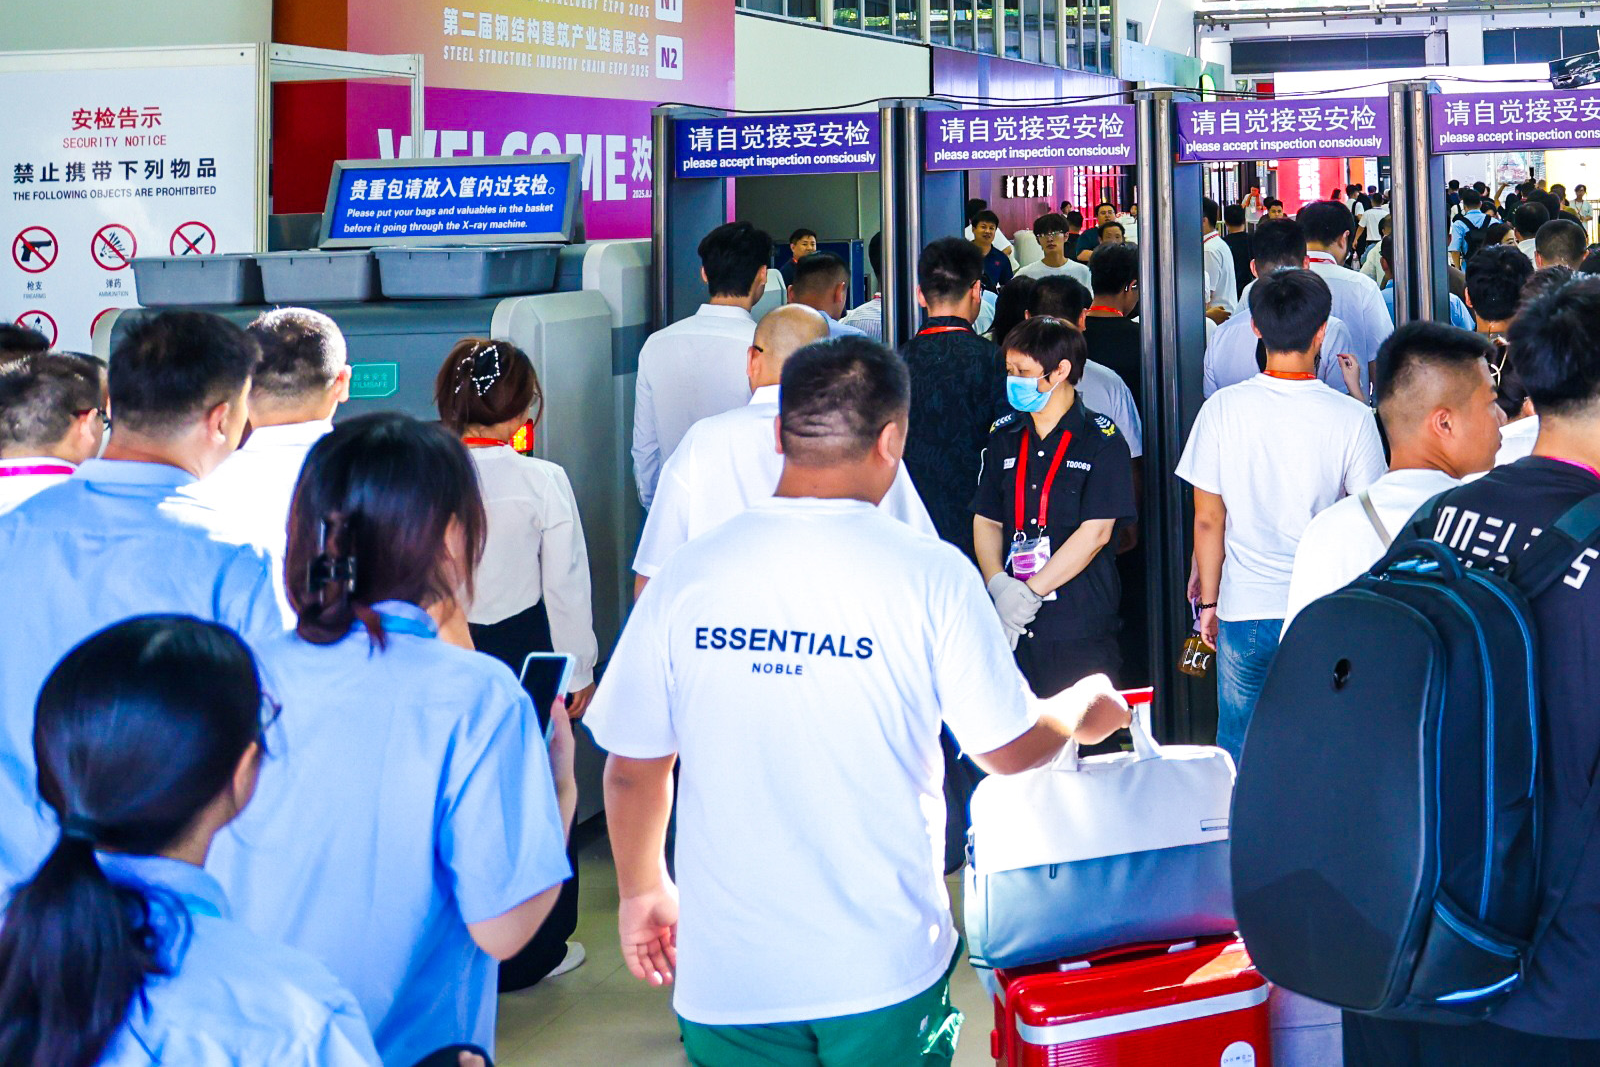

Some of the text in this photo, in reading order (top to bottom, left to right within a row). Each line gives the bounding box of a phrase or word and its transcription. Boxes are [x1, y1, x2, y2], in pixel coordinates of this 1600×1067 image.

[603, 0, 625, 14] EXPO
[629, 4, 650, 18] 2025
[443, 7, 650, 57] 第二届钢结构建筑产业链展览会
[443, 45, 650, 77] STEEL STRUCTURE INDUSTRY CHAIN EXPO 2025
[661, 47, 678, 69] N2
[71, 106, 162, 131] 安检告示
[940, 112, 1125, 143] 请自觉接受安检
[1191, 105, 1376, 135] 请自觉接受安检
[63, 135, 167, 149] SECURITY NOTICE
[688, 120, 870, 152] 请自觉接受安检
[1186, 135, 1382, 154] please accept inspection consciously
[1439, 130, 1474, 145] please
[1477, 130, 1513, 144] accept
[1515, 128, 1573, 142] inspection
[683, 151, 876, 171] please accept inspection consciously
[934, 143, 1130, 163] please accept inspection consciously
[13, 157, 217, 184] 禁止携带下列物品
[13, 185, 217, 201] THE FOLLOWING OBJECTS ARE PROHITBITED
[350, 174, 555, 201] 贵重包请放入筐内过安检。
[347, 203, 553, 218] Please put your bags and valuables in the basket
[343, 219, 528, 234] before it going through the X-ray machine.
[27, 281, 43, 291] 枪支
[105, 278, 122, 288] 弹药
[695, 627, 873, 659] ESSENTIALS
[751, 663, 803, 676] NOBLE
